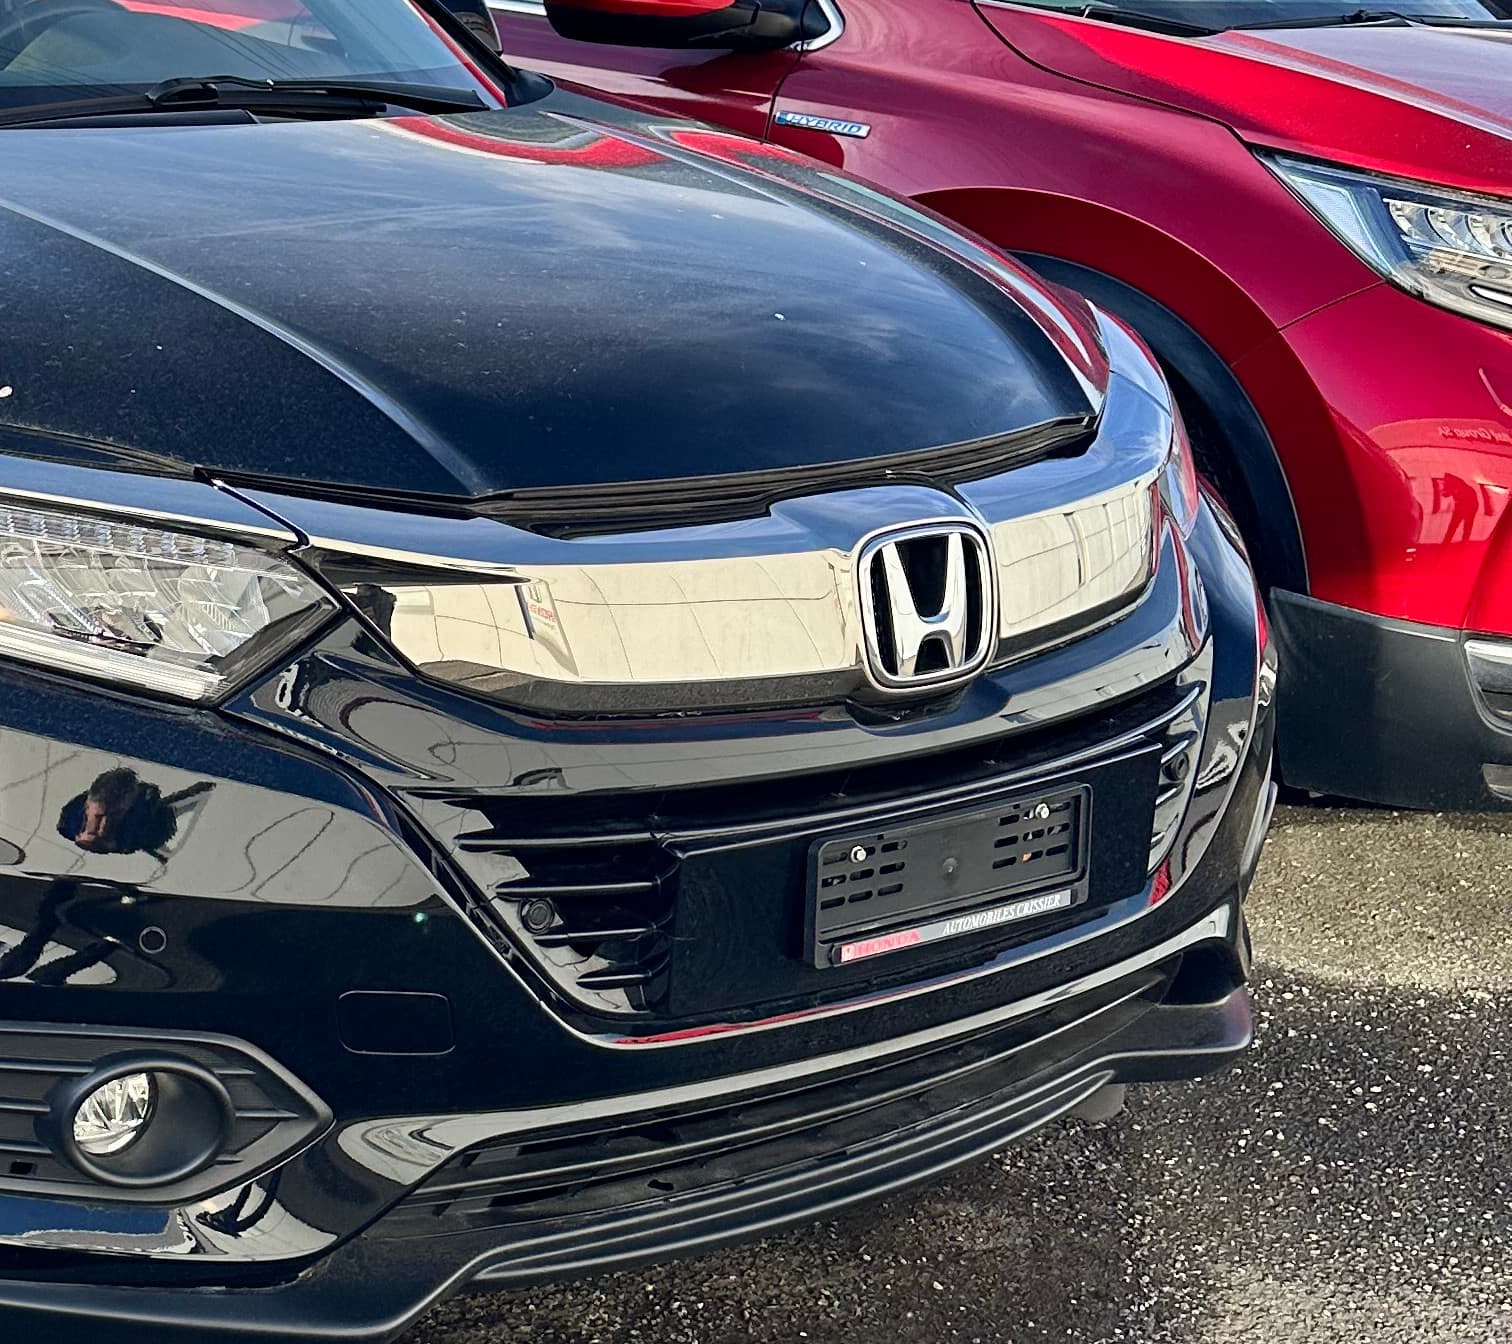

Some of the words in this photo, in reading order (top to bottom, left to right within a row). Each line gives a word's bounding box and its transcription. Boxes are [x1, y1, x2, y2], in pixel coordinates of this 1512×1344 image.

[790, 115, 862, 133] HYBRID
[856, 929, 920, 955] HONDA
[943, 905, 1015, 935] AUTOMOBILES
[1016, 894, 1061, 917] CRISSIER
